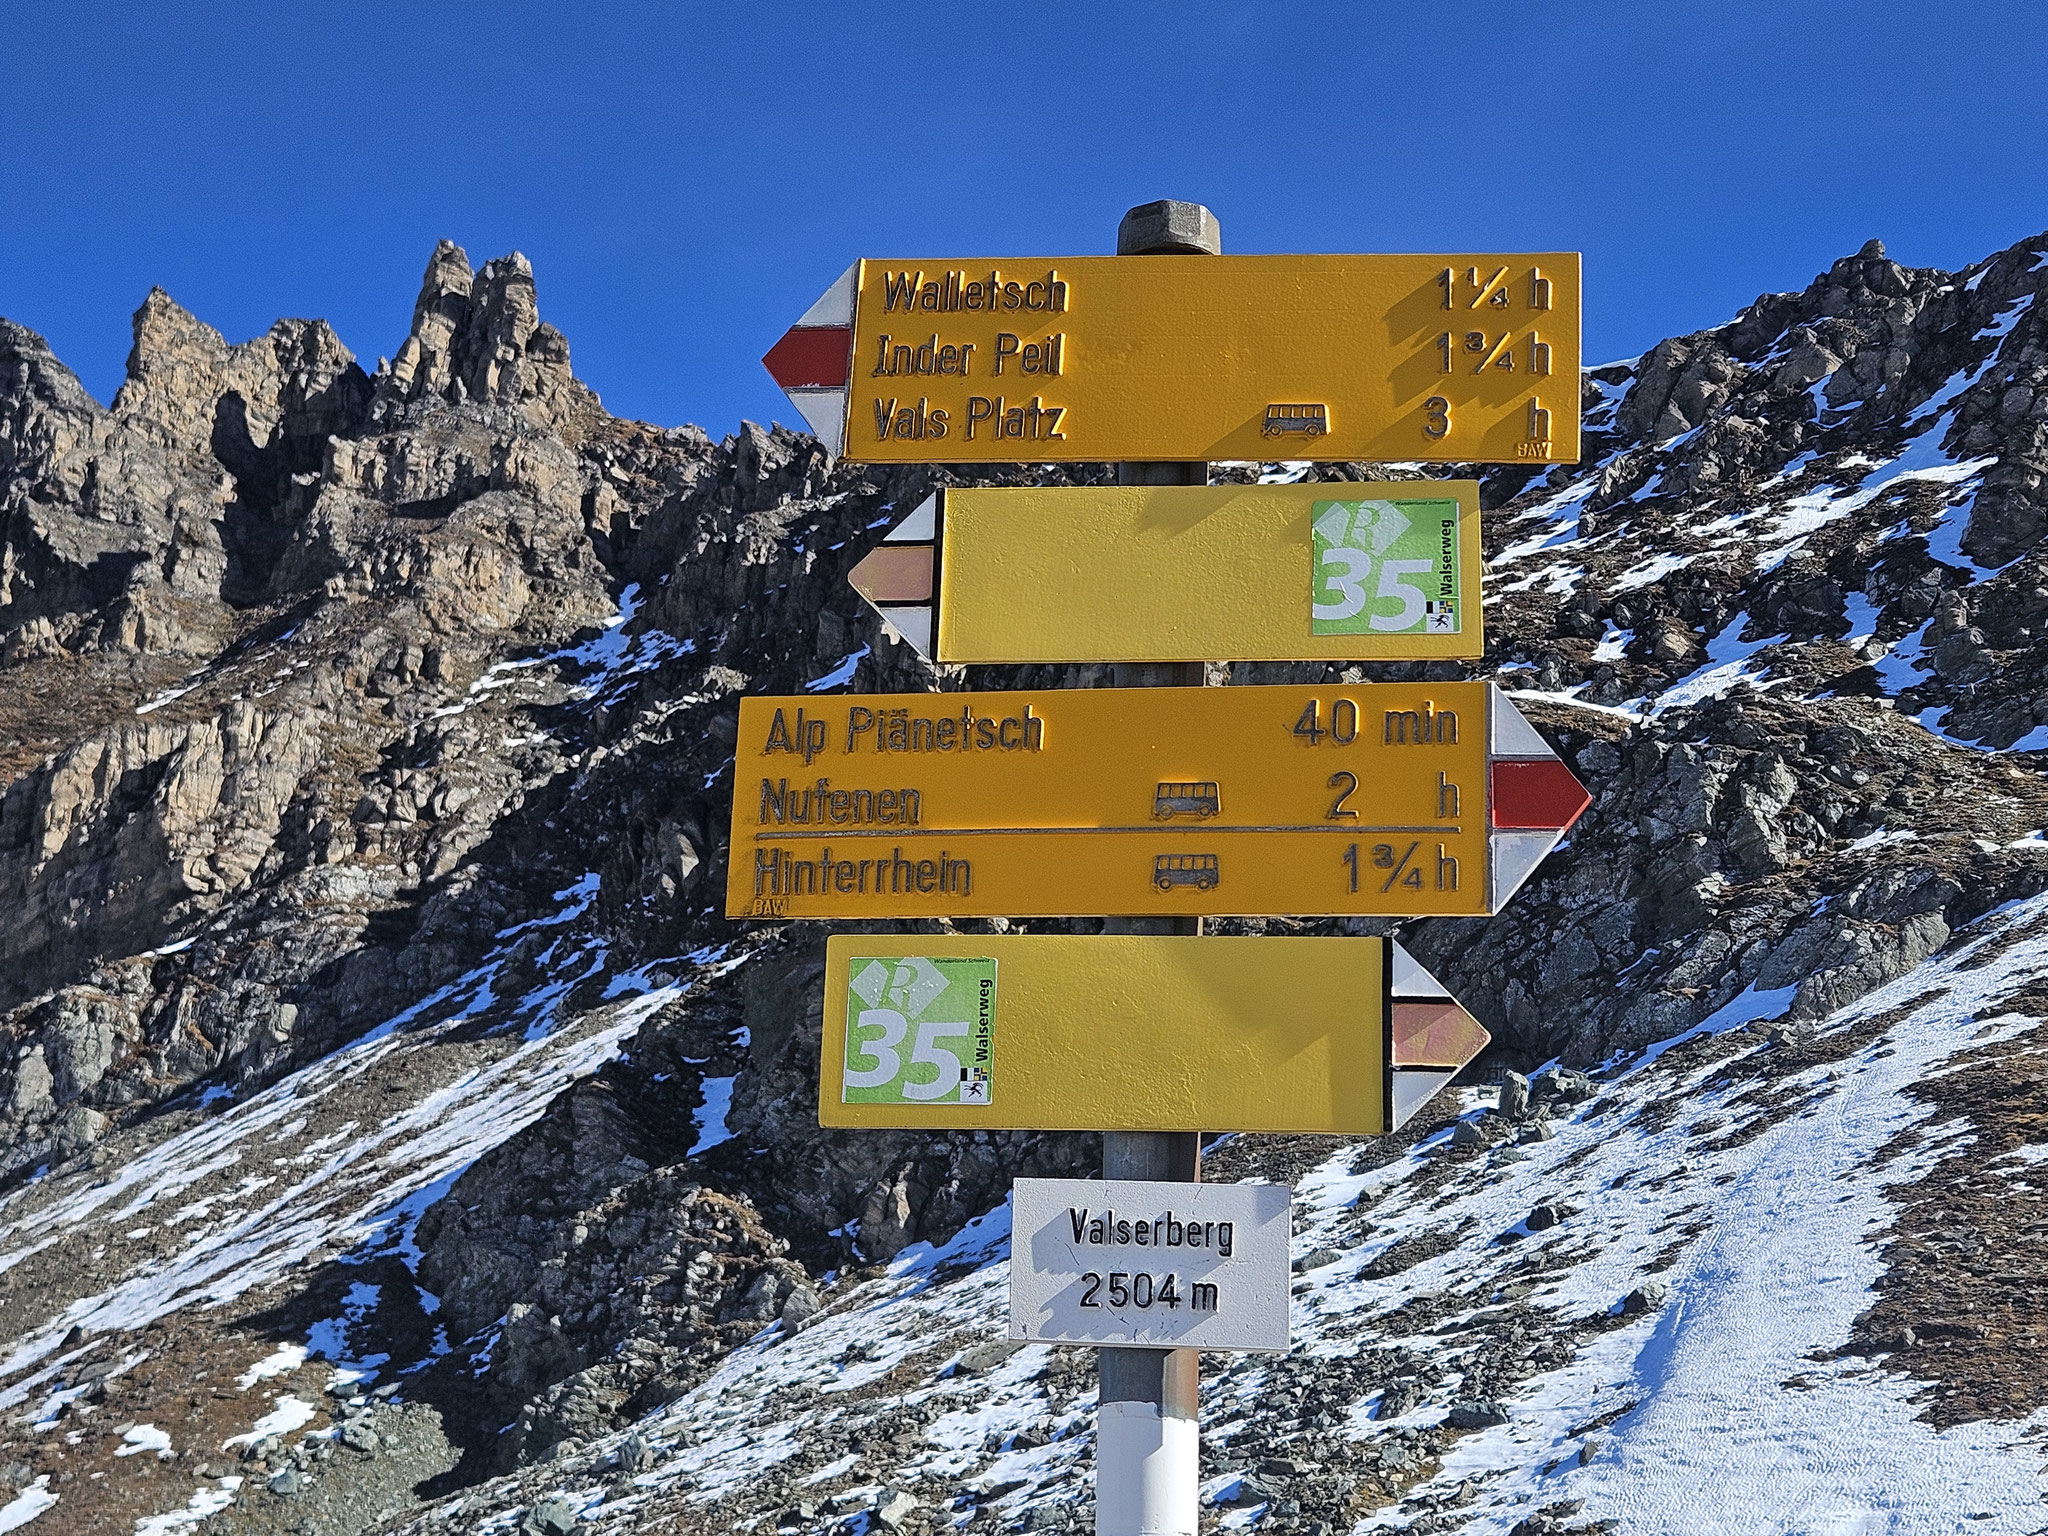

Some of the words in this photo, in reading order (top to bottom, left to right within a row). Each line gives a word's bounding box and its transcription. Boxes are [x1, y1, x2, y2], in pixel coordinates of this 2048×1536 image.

[884, 269, 1070, 314] Walletsch
[1530, 266, 1553, 311] h
[872, 333, 977, 377] Inder
[995, 332, 1067, 377] Peil
[1530, 331, 1553, 376] h
[875, 398, 950, 441] Vals
[966, 396, 1068, 441] Platz
[1423, 396, 1452, 441] 3
[1530, 396, 1553, 442] h
[1440, 519, 1455, 596] Walserweg
[1313, 547, 1433, 632] 35
[765, 707, 827, 767] Alp
[847, 703, 1046, 753] Piänetsch
[1292, 698, 1360, 746] 40
[1383, 699, 1459, 745] min
[759, 777, 922, 825] Nufenen
[1328, 770, 1360, 820] 2
[1437, 770, 1460, 818] h
[754, 847, 973, 897] Hinterrhein
[1437, 842, 1460, 891] h
[975, 979, 993, 1062] Walserweg
[845, 1008, 970, 1101] 35
[1068, 1207, 1235, 1257] Valserberg
[1080, 1272, 1181, 1309] 2504
[1191, 1281, 1219, 1312] m
